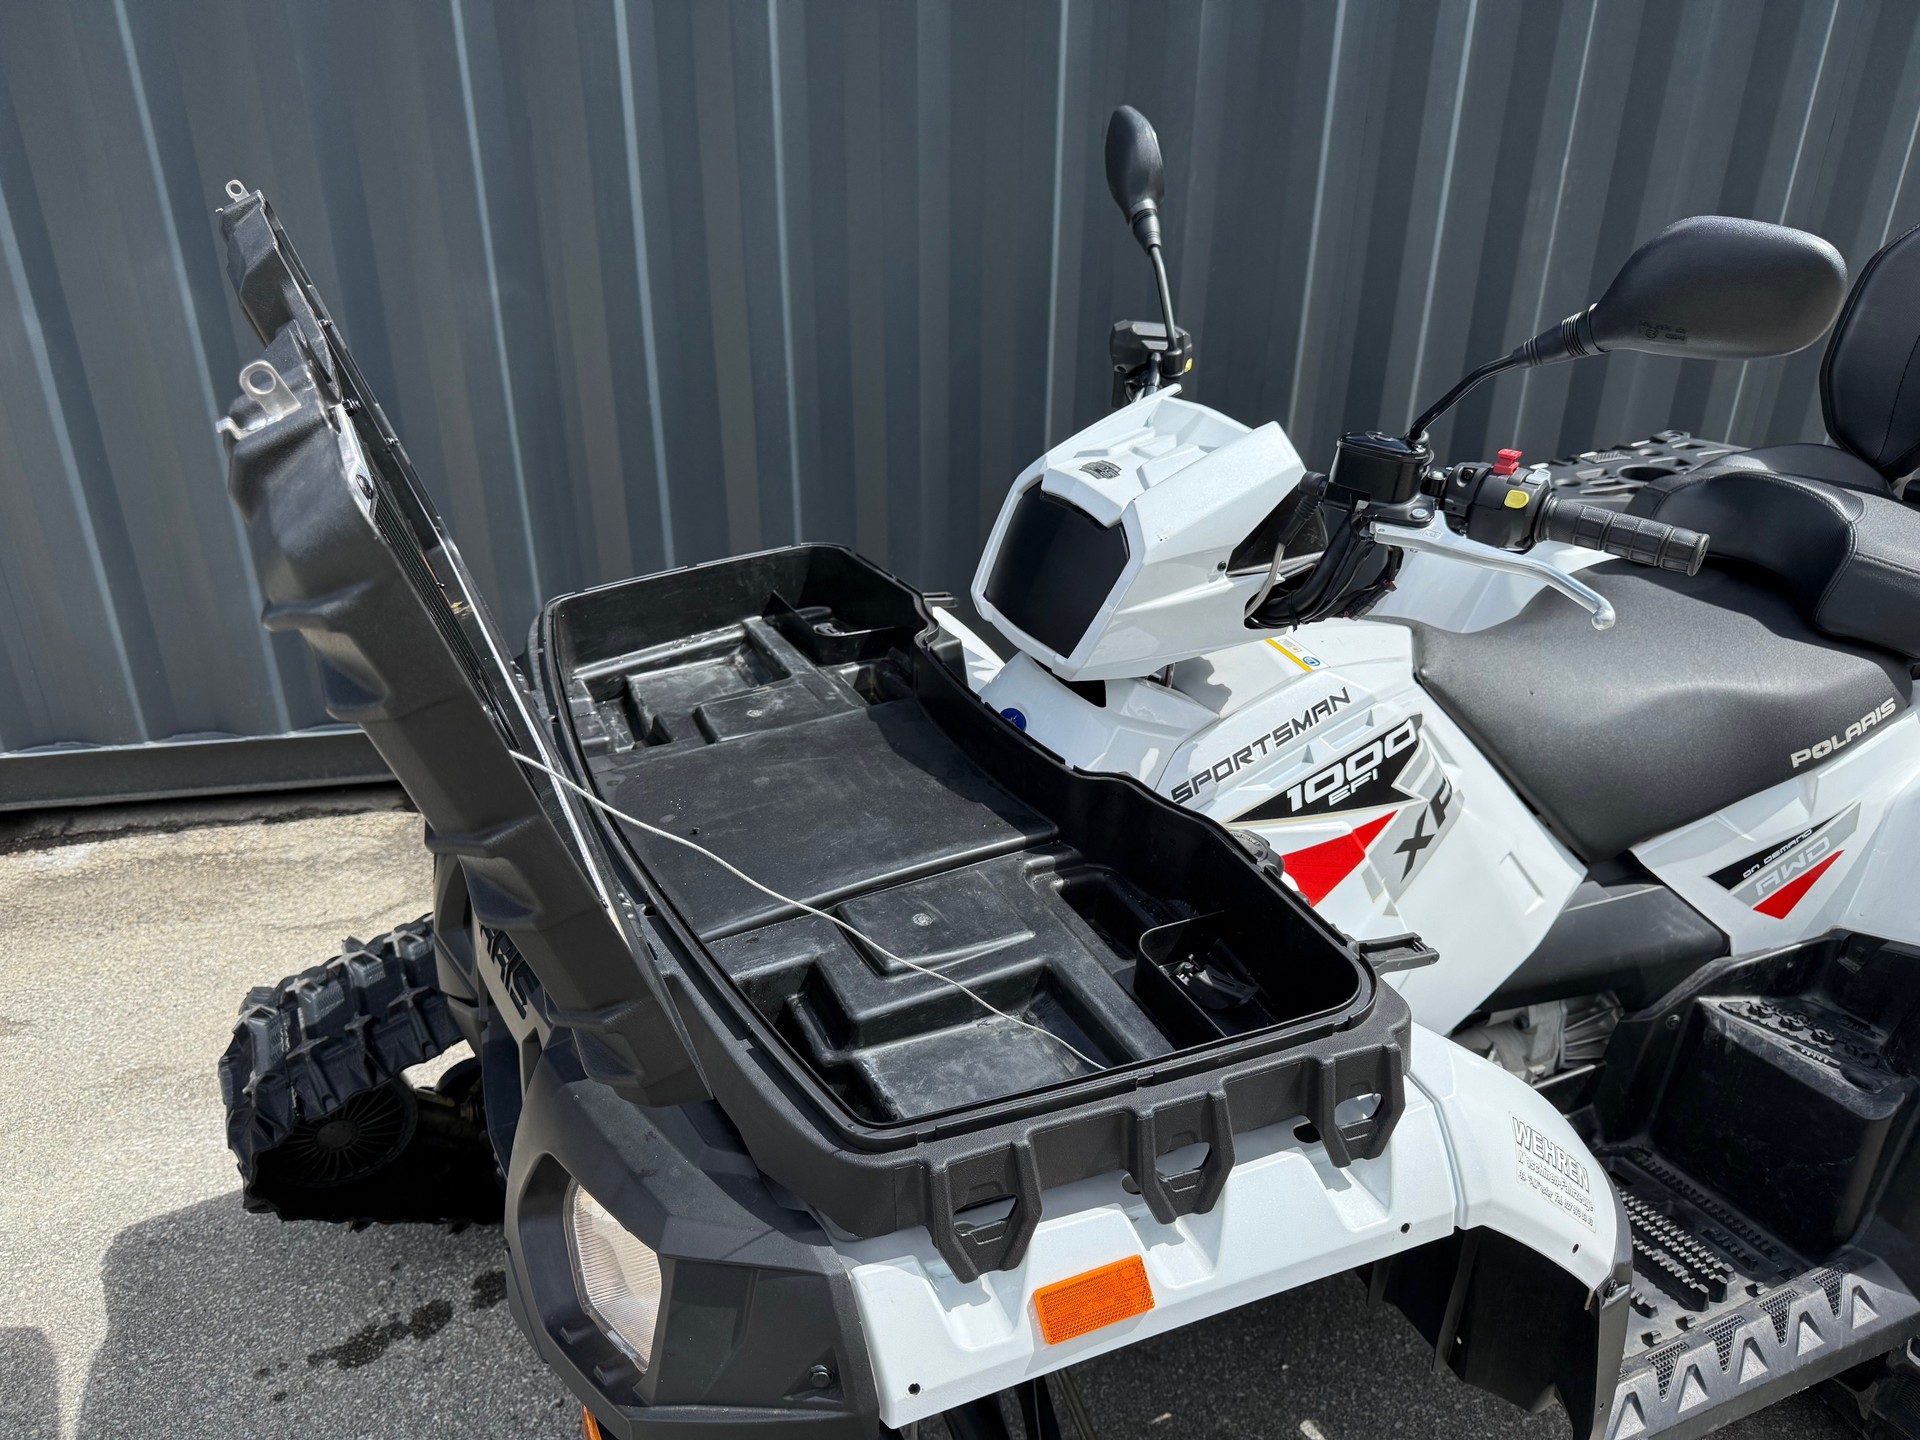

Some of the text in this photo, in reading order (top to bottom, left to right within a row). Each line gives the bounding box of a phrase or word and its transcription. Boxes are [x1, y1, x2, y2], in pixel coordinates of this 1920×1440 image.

[1170, 686, 1351, 803] SPORTSMAN
[1286, 718, 1418, 812] 1000
[1790, 697, 1896, 768] POLARIS
[1328, 770, 1379, 806] EFI
[1754, 836, 1831, 897] AWD
[1512, 1116, 1590, 1193] WEHREN
